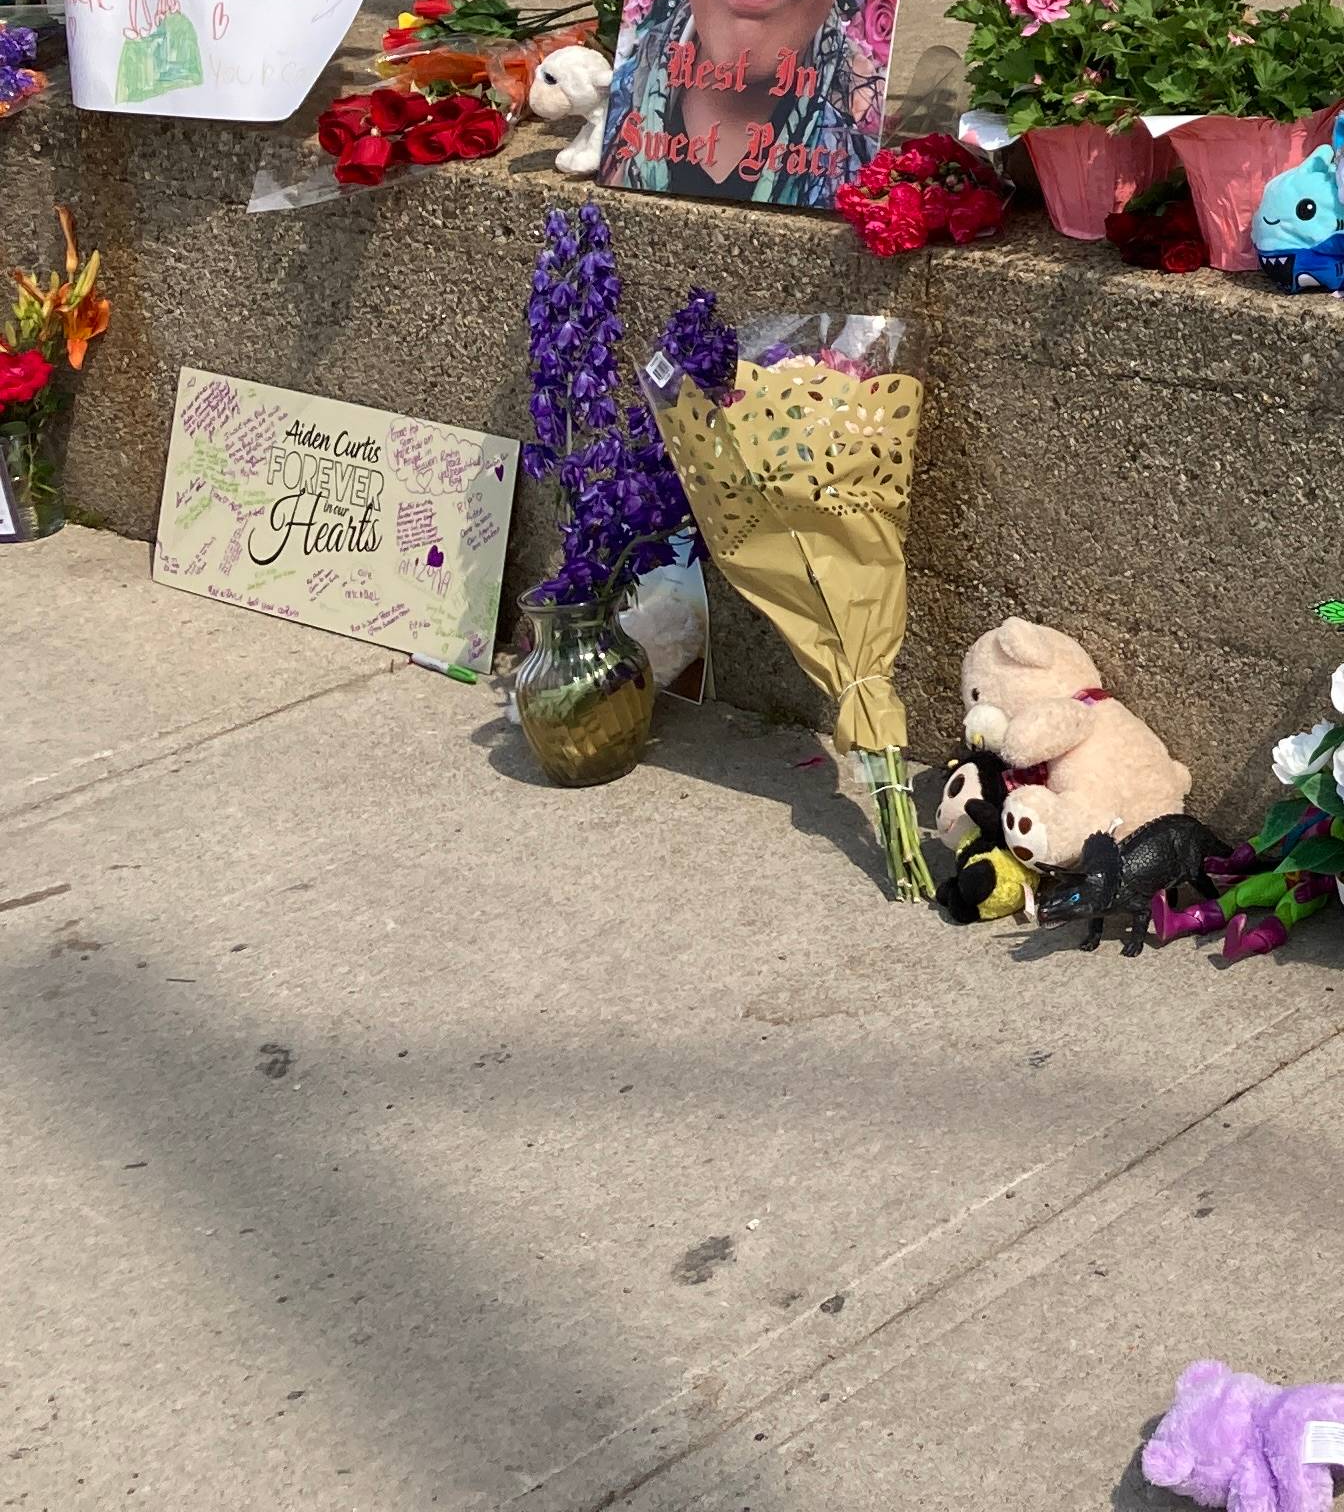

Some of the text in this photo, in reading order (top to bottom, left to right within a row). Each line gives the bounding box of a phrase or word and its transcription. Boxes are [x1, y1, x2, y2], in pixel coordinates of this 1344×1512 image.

[665, 40, 819, 98] Rest In
[615, 111, 850, 182] Sweet Peace
[282, 419, 382, 464] Aiden Curtis
[266, 445, 385, 513] FOREVER
[248, 487, 384, 566] Hearts
